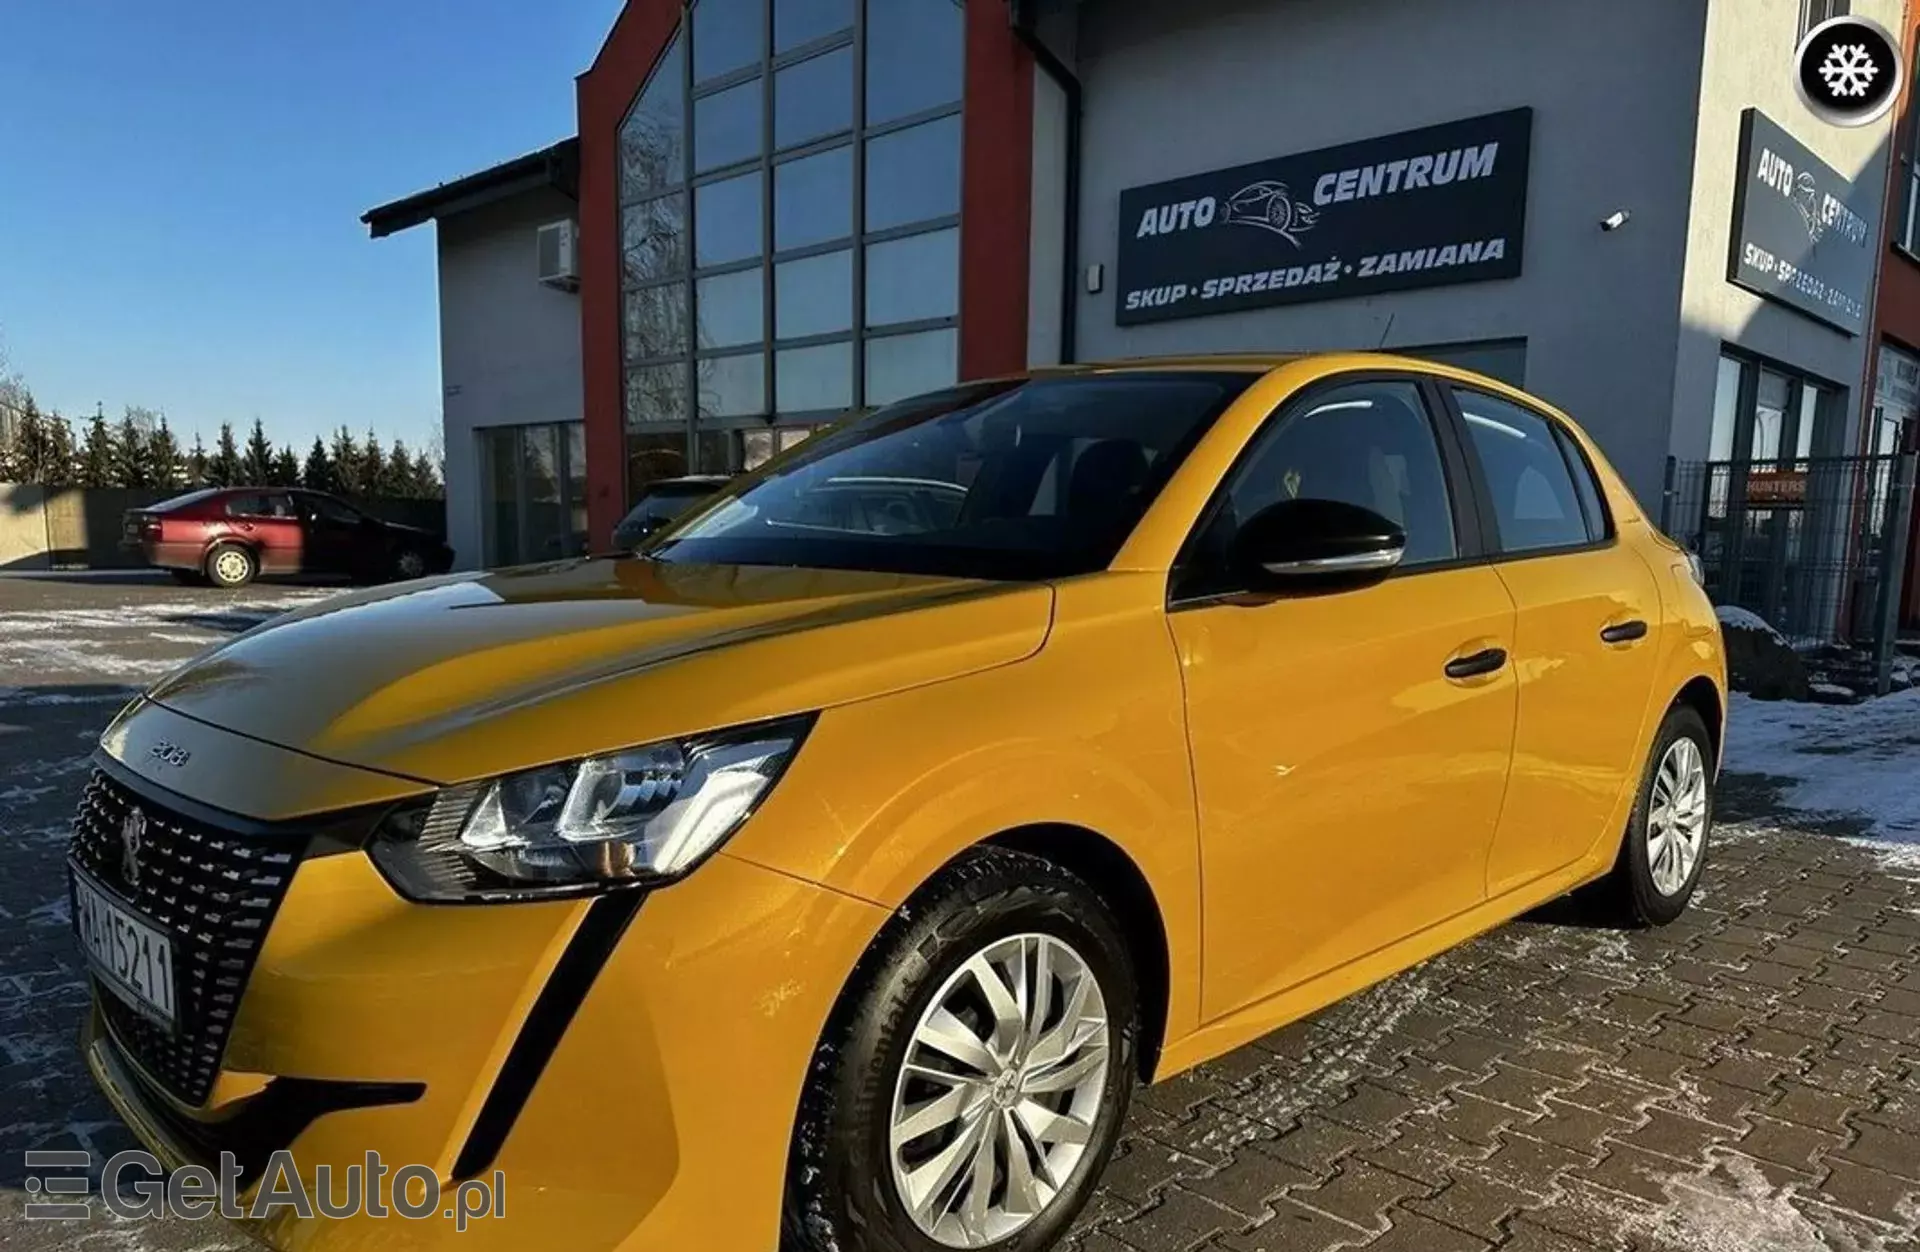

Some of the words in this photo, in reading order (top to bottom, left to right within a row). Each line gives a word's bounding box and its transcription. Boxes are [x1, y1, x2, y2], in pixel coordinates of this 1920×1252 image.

[1136, 196, 1217, 239] AUTO
[1312, 141, 1500, 207] CENTRUM
[1756, 147, 1794, 198] AUTO
[1125, 284, 1188, 311] SKUP
[1201, 255, 1341, 301] SPRZEDAŻ
[1357, 238, 1506, 278] ZAMIANA
[1743, 242, 1774, 273] SKUP
[149, 736, 191, 768] 208
